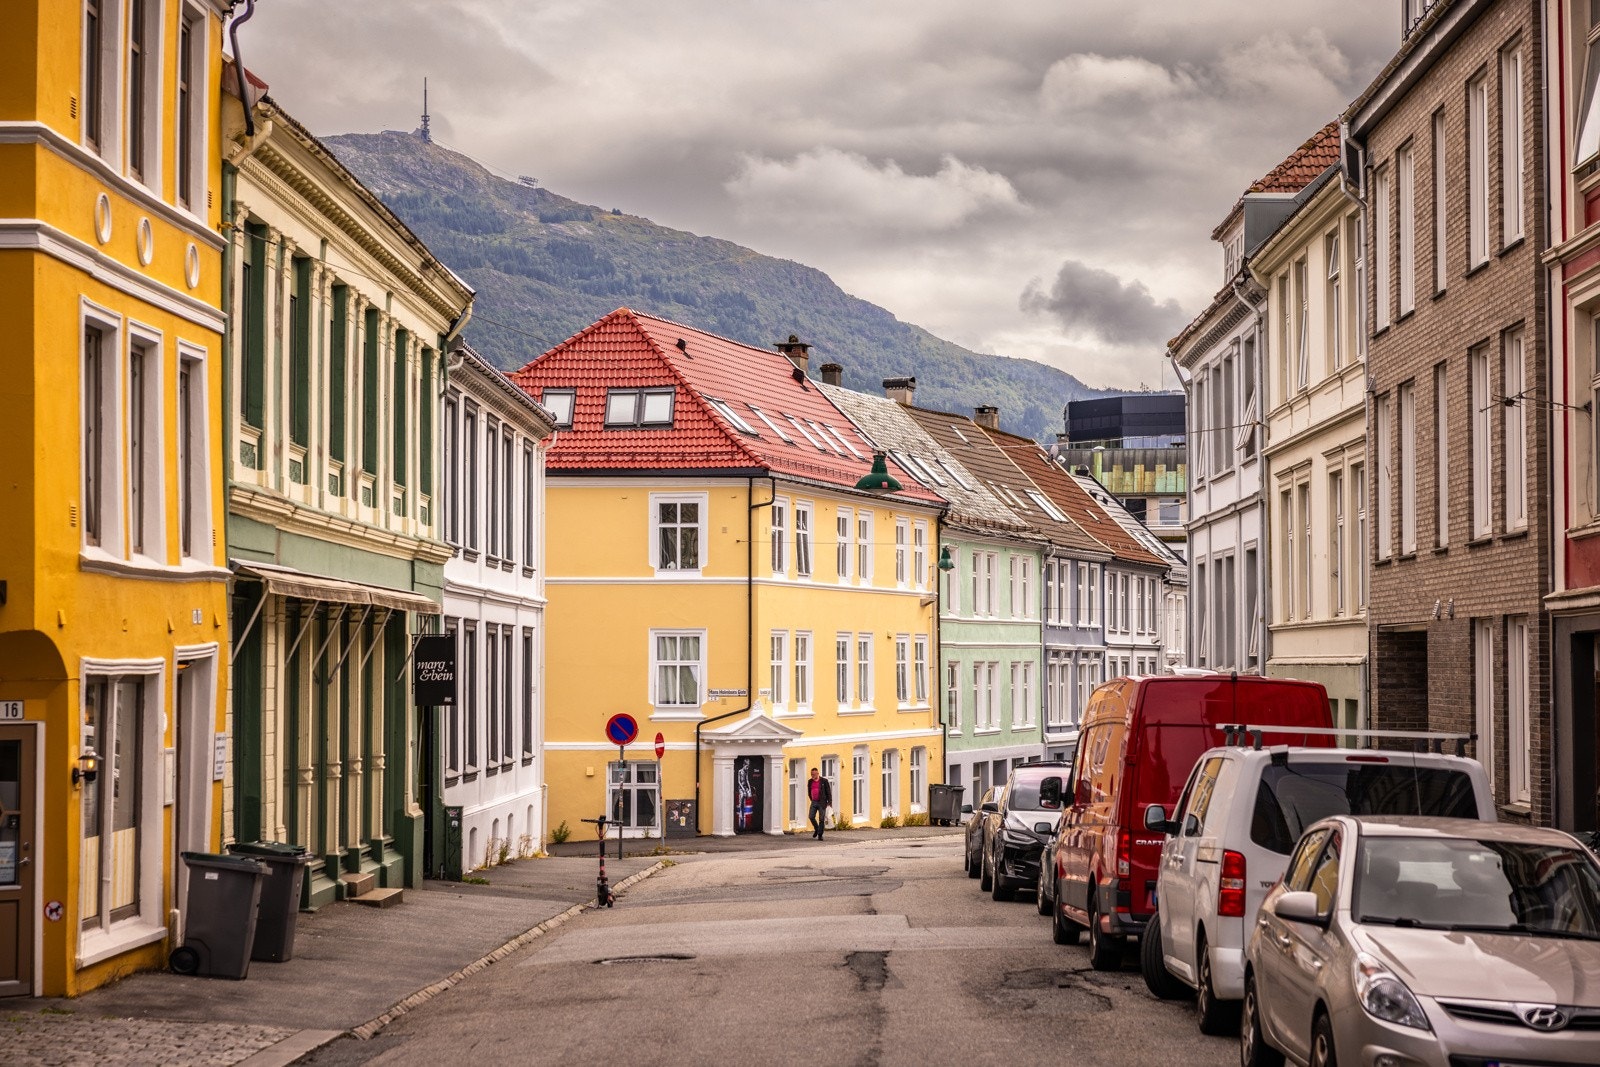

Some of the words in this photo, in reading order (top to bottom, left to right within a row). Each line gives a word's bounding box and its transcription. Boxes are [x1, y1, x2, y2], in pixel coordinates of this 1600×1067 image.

[416, 661, 446, 672] marg
[419, 669, 454, 681] &bein
[4, 702, 18, 718] 16
